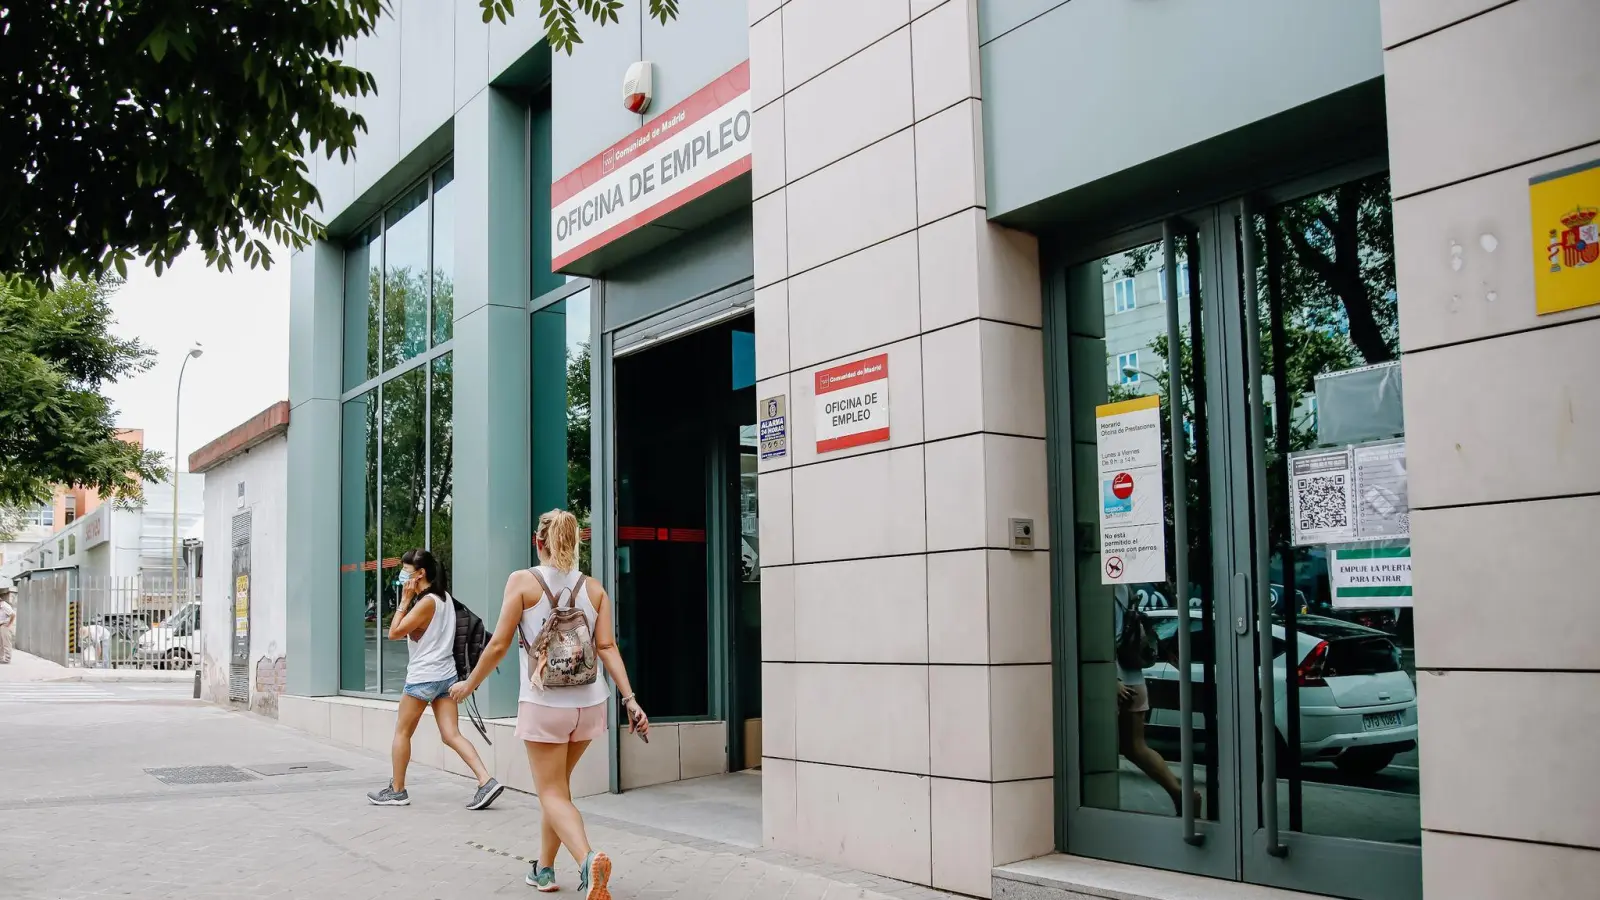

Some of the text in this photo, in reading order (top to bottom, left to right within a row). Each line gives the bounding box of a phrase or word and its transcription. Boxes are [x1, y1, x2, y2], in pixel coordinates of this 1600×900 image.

[615, 110, 685, 160] Comunidad de Madrid
[556, 109, 750, 241] OFICINA DE EMPLEO
[829, 371, 856, 383] Comunidad
[863, 363, 882, 374] Madrid
[825, 392, 878, 414] OFICINA DE
[761, 417, 784, 429] ALARMA
[832, 408, 871, 427] EMPLEO
[1100, 421, 1121, 430] Horario
[1100, 429, 1117, 437] Oficina
[1104, 539, 1131, 547] permitido
[1340, 565, 1368, 573] EMPUJE
[1350, 574, 1401, 583] PARA ENTRAR
